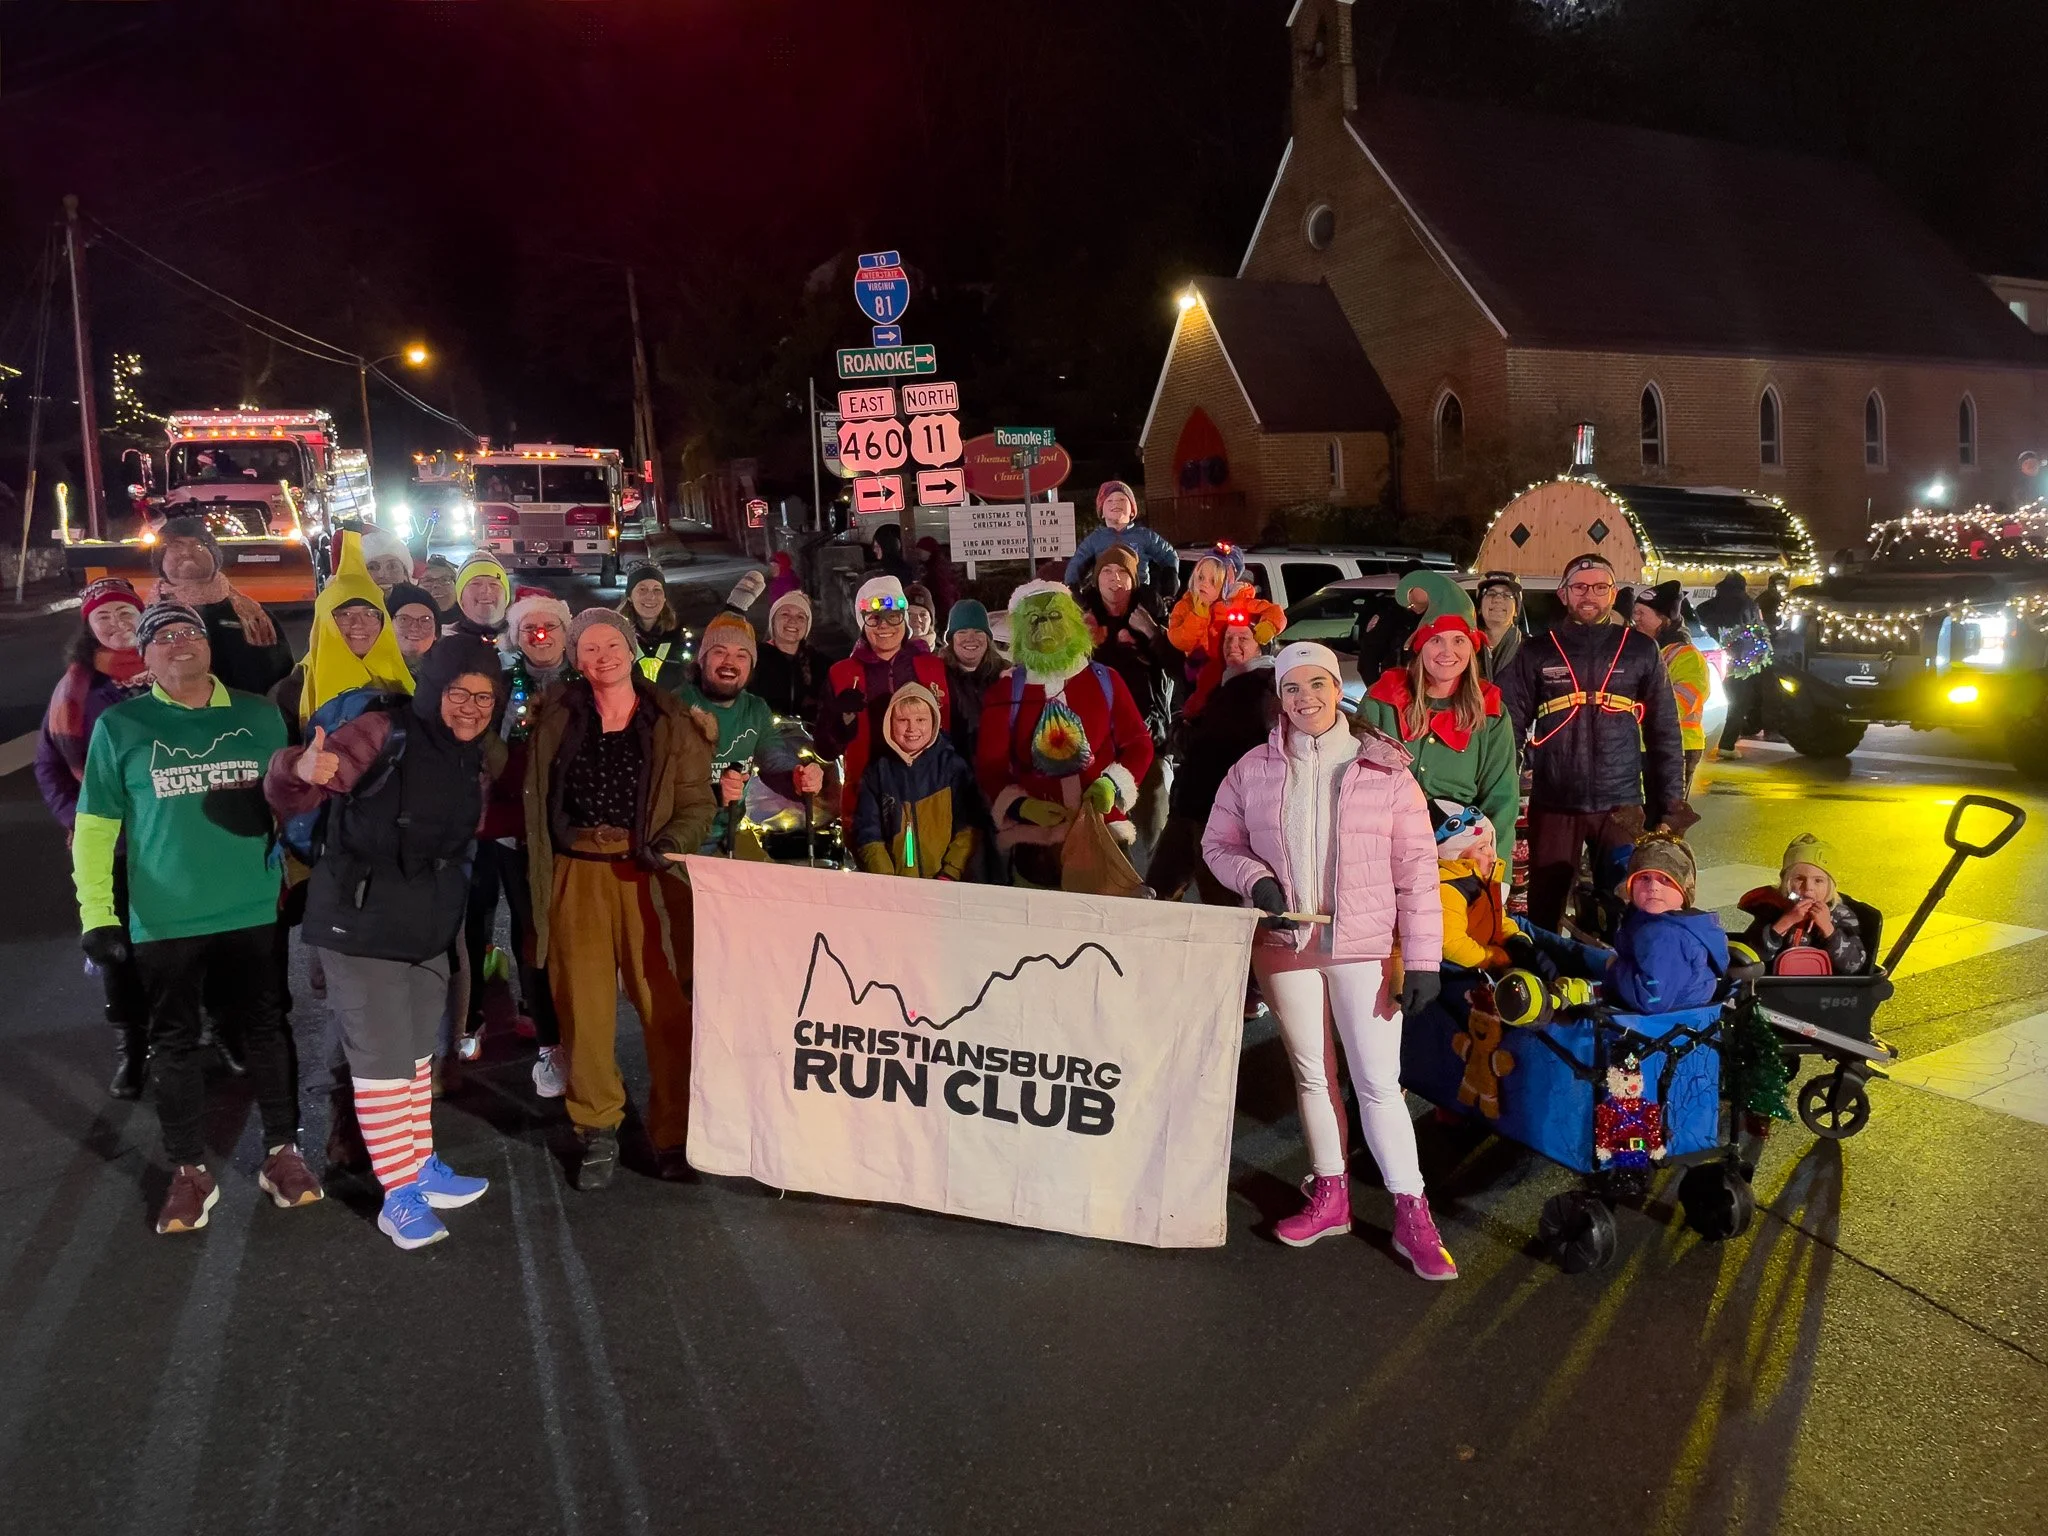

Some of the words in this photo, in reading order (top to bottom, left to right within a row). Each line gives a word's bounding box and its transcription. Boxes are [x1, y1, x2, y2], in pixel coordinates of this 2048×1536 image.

[873, 255, 887, 266] TO
[862, 270, 899, 280] INTERSTATE
[867, 281, 895, 292] VIRGINIA
[875, 295, 892, 317] 81
[843, 350, 915, 374] ROANOKE
[849, 395, 885, 413] EAST
[907, 388, 955, 408] NORTH
[843, 428, 903, 461] 460
[923, 423, 946, 454] 11
[997, 429, 1042, 446] Roanoke
[1043, 429, 1051, 438] ST
[976, 453, 1011, 464] Thomas
[972, 511, 1010, 520] CHRISTMAS
[973, 520, 1012, 529] CHRISTMAS
[997, 538, 1026, 546] WORSHIP
[151, 760, 259, 778] CHRISTIANSBURG
[153, 773, 203, 792] RUN
[155, 788, 187, 799] EVERY
[188, 785, 209, 794] DAY
[794, 1019, 1122, 1090] CHRISTIANSBURG
[794, 1047, 928, 1108] RUN
[943, 1069, 1116, 1136] CLUB
